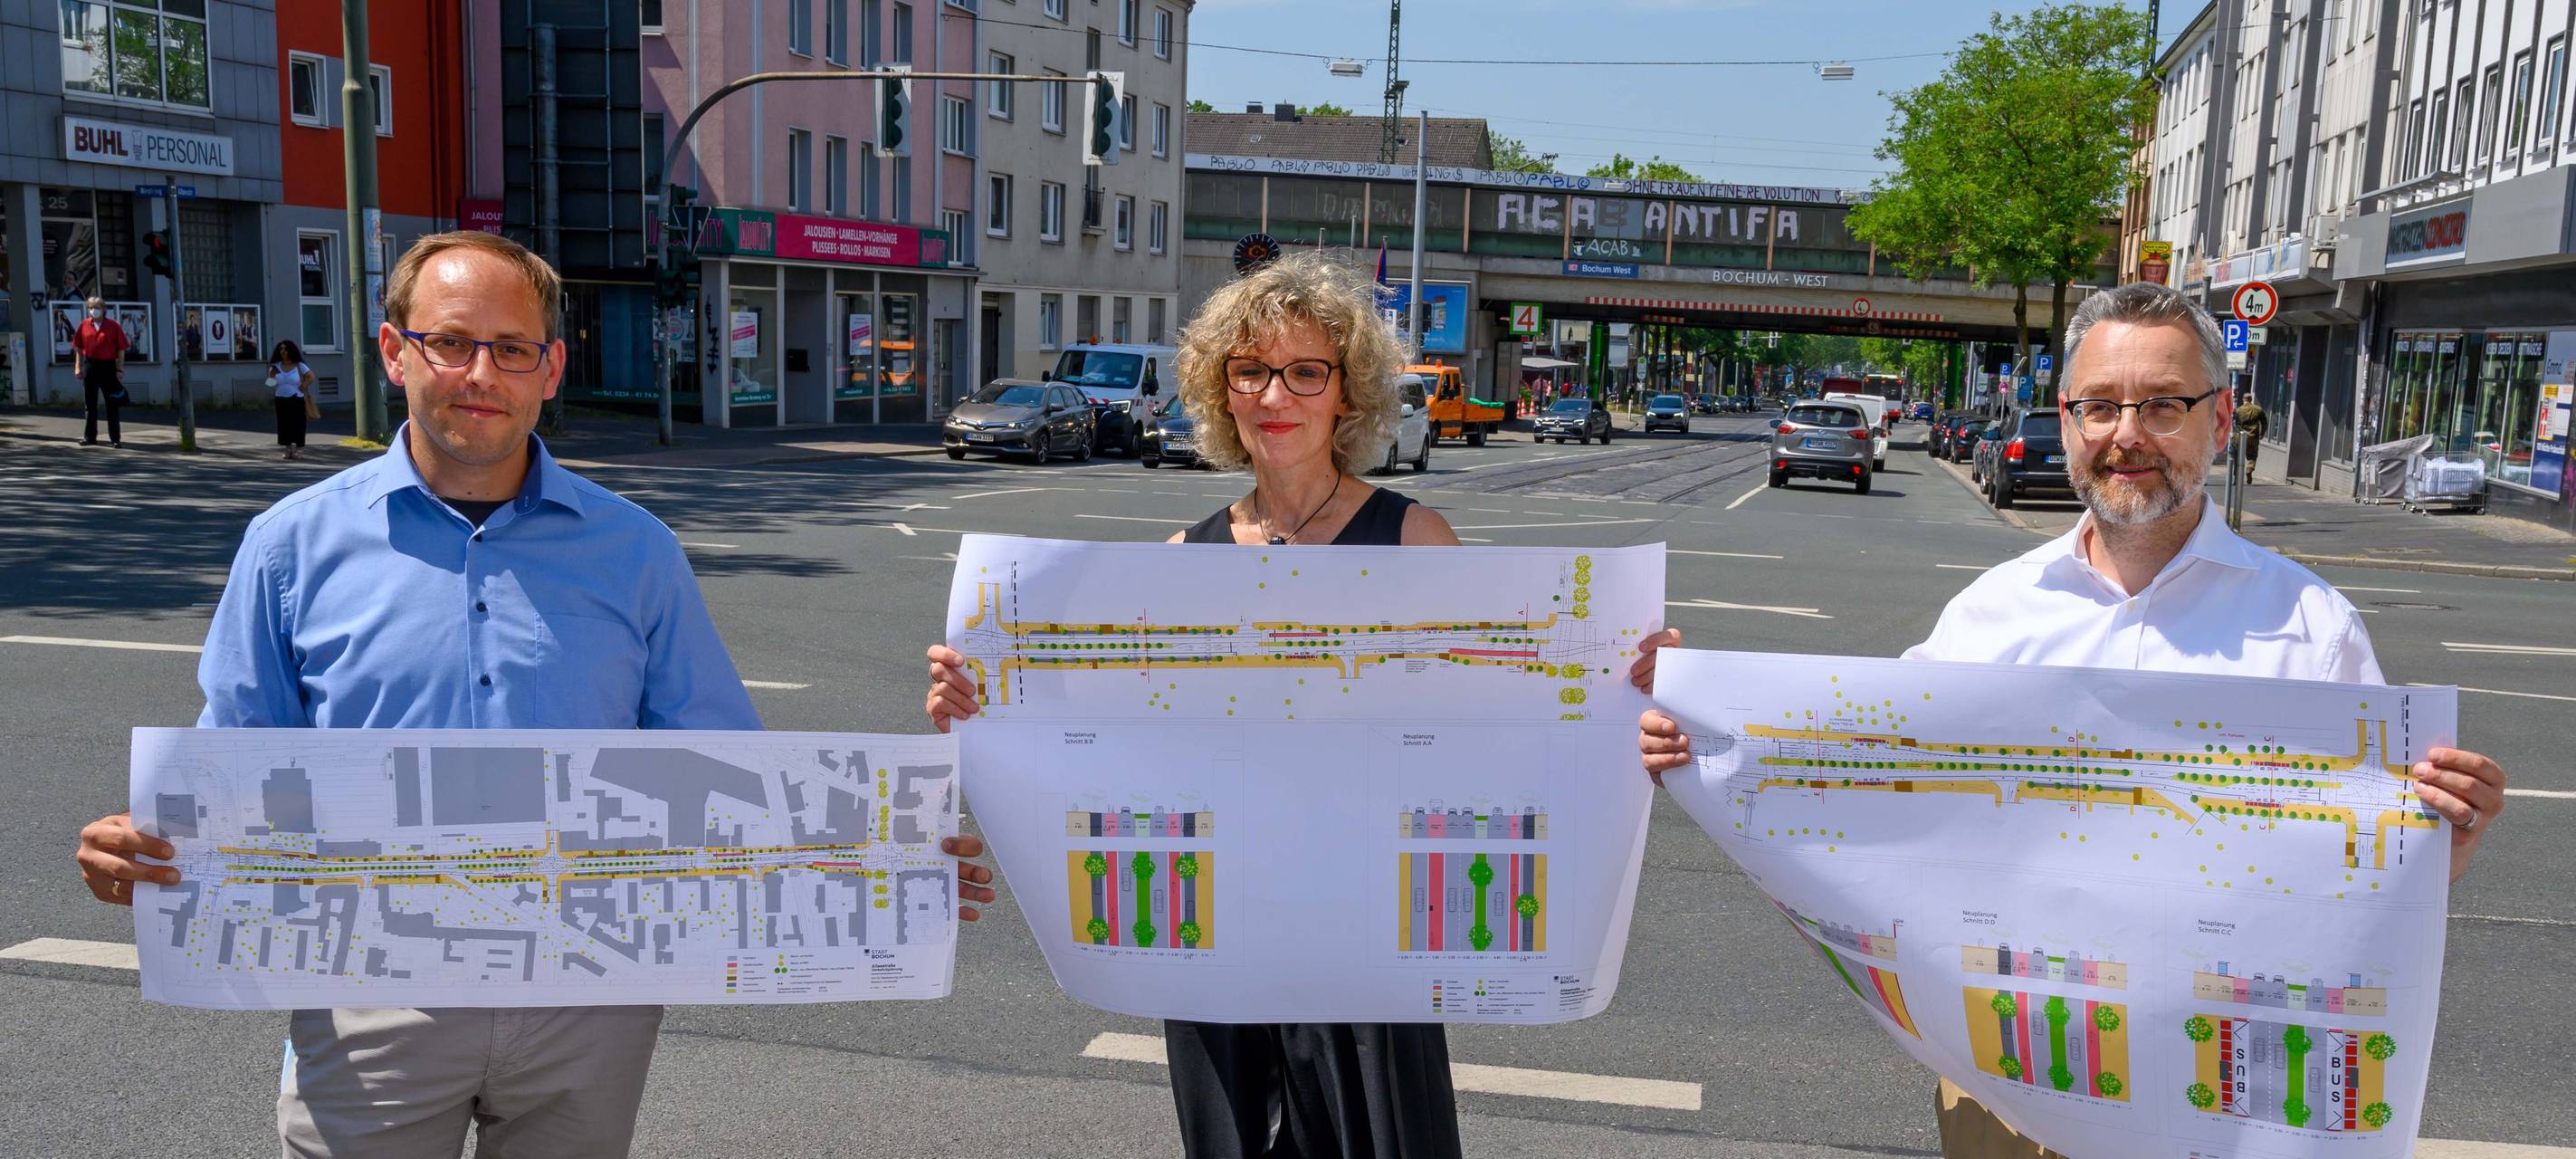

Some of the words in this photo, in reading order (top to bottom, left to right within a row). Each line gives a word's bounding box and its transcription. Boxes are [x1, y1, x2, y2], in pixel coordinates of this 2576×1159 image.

[74, 126, 129, 157] BUHL
[148, 135, 226, 168] PERSONAL
[1660, 182, 1705, 197] FRAUEN
[49, 196, 68, 209] 25
[1645, 201, 1798, 241] ANTIFA
[804, 224, 836, 240] JALOUSIEN
[812, 241, 837, 254] PLISSEES
[840, 243, 861, 256] ROLLOS
[863, 244, 891, 258] MARKISEN
[1586, 239, 1629, 257] ACAB
[1582, 263, 1612, 274] Bochum
[1613, 265, 1631, 275] West
[1713, 270, 1779, 285] BOCHUM
[1793, 273, 1829, 288] WEST
[2246, 294, 2264, 313] 4m
[1517, 305, 1535, 331] 4
[2228, 324, 2241, 349] P
[2040, 358, 2049, 369] P
[2019, 377, 2027, 388] P
[1962, 910, 1998, 919] Neuplanung
[1962, 916, 1983, 924] Schnitt
[2198, 919, 2236, 930] Neuplanung
[2198, 926, 2220, 935] Schnitt
[2236, 1049, 2246, 1092] BUS
[2332, 1057, 2341, 1103] BUS
